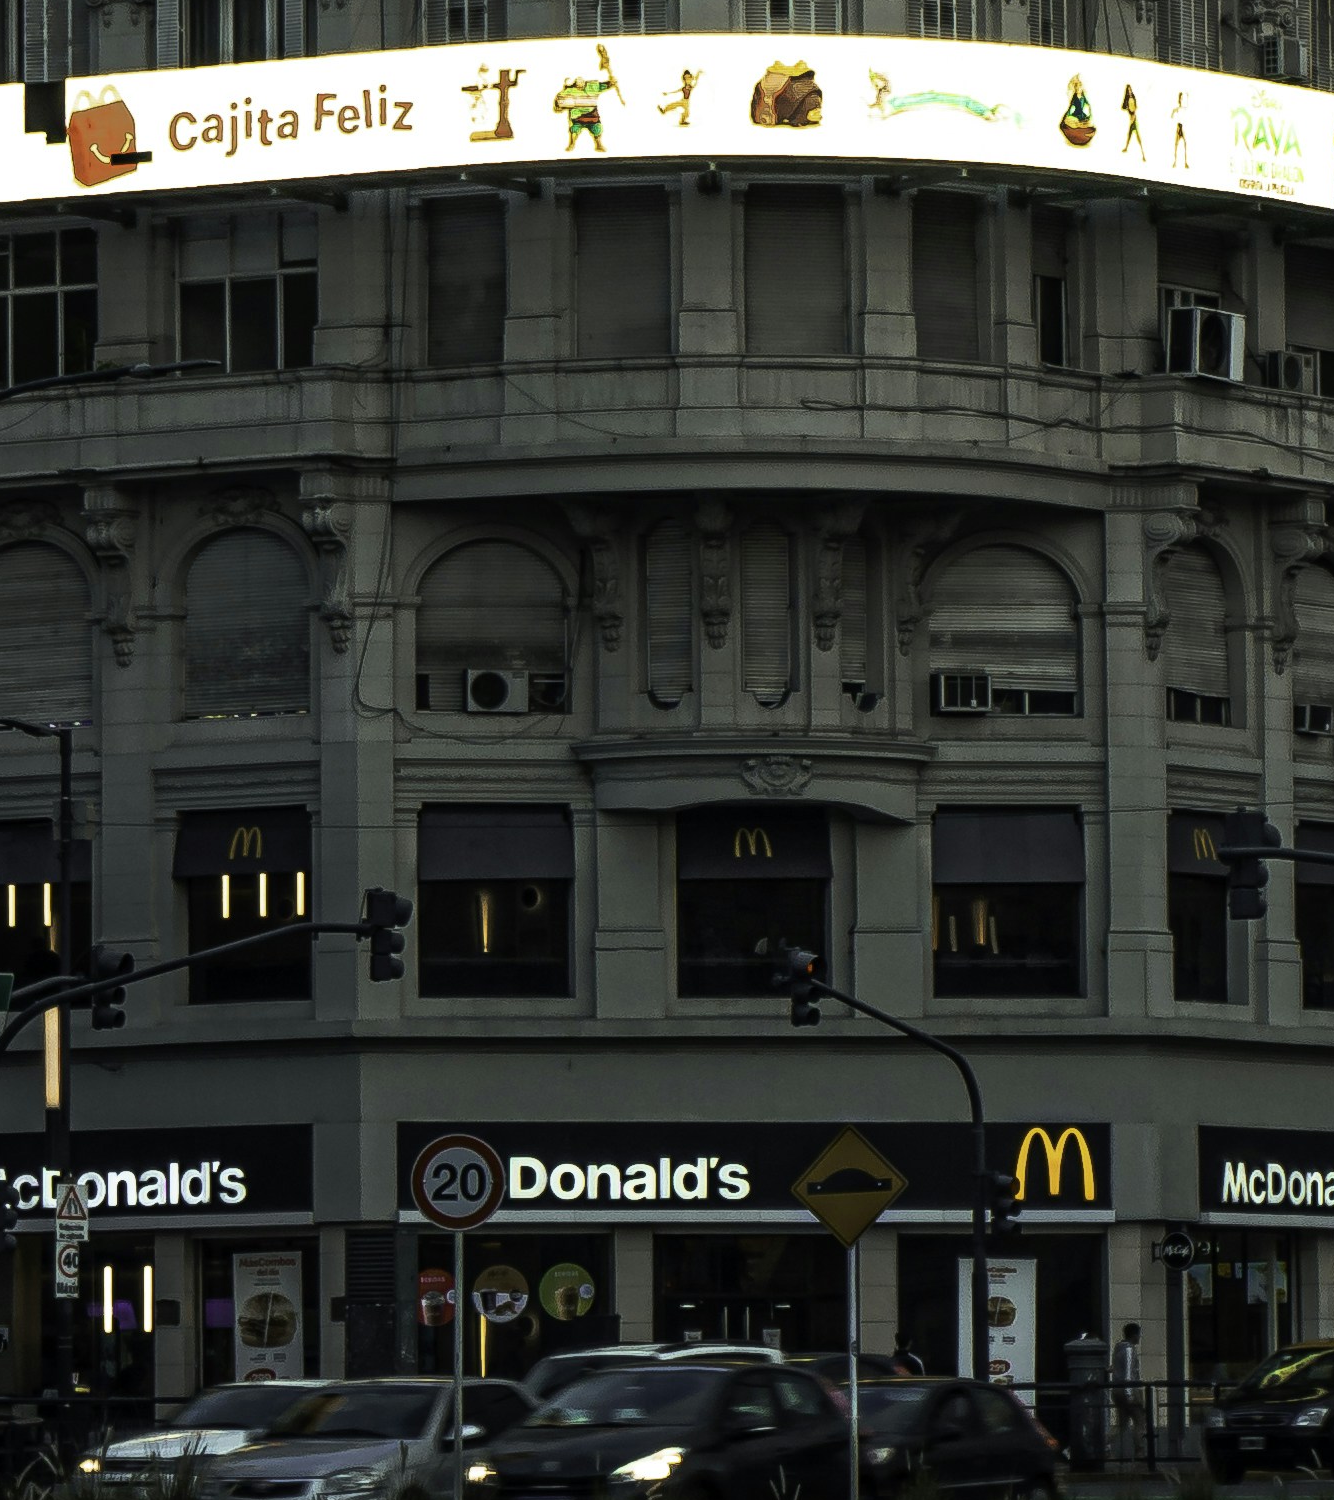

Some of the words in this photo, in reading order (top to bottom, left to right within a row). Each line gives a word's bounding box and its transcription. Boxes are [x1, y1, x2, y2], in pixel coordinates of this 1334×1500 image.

[169, 97, 299, 157] Cajita
[315, 84, 414, 134] Feliz
[432, 1163, 486, 1202] 20
[508, 1156, 751, 1201] Donald's
